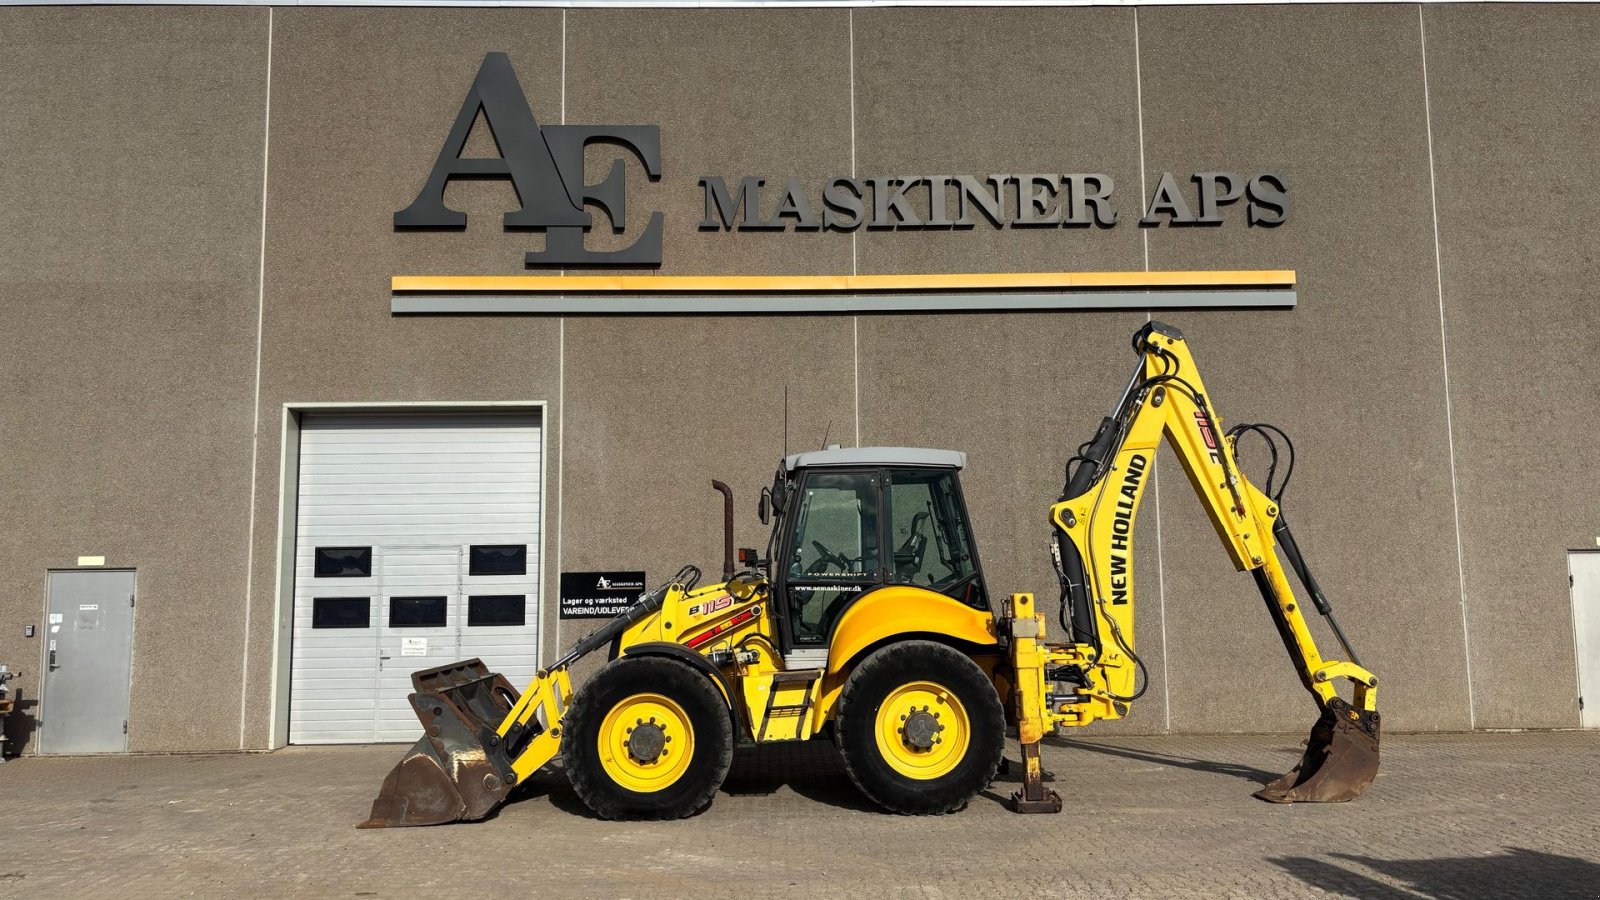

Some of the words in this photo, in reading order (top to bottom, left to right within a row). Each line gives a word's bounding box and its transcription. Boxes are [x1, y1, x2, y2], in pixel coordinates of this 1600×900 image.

[394, 52, 663, 269] AE
[698, 174, 1117, 232] MASKINER
[1139, 172, 1291, 228] APS
[1111, 454, 1147, 550] HOLLAND
[563, 597, 583, 605] Lager
[596, 576, 611, 588] AE
[1111, 555, 1127, 605] NEW
